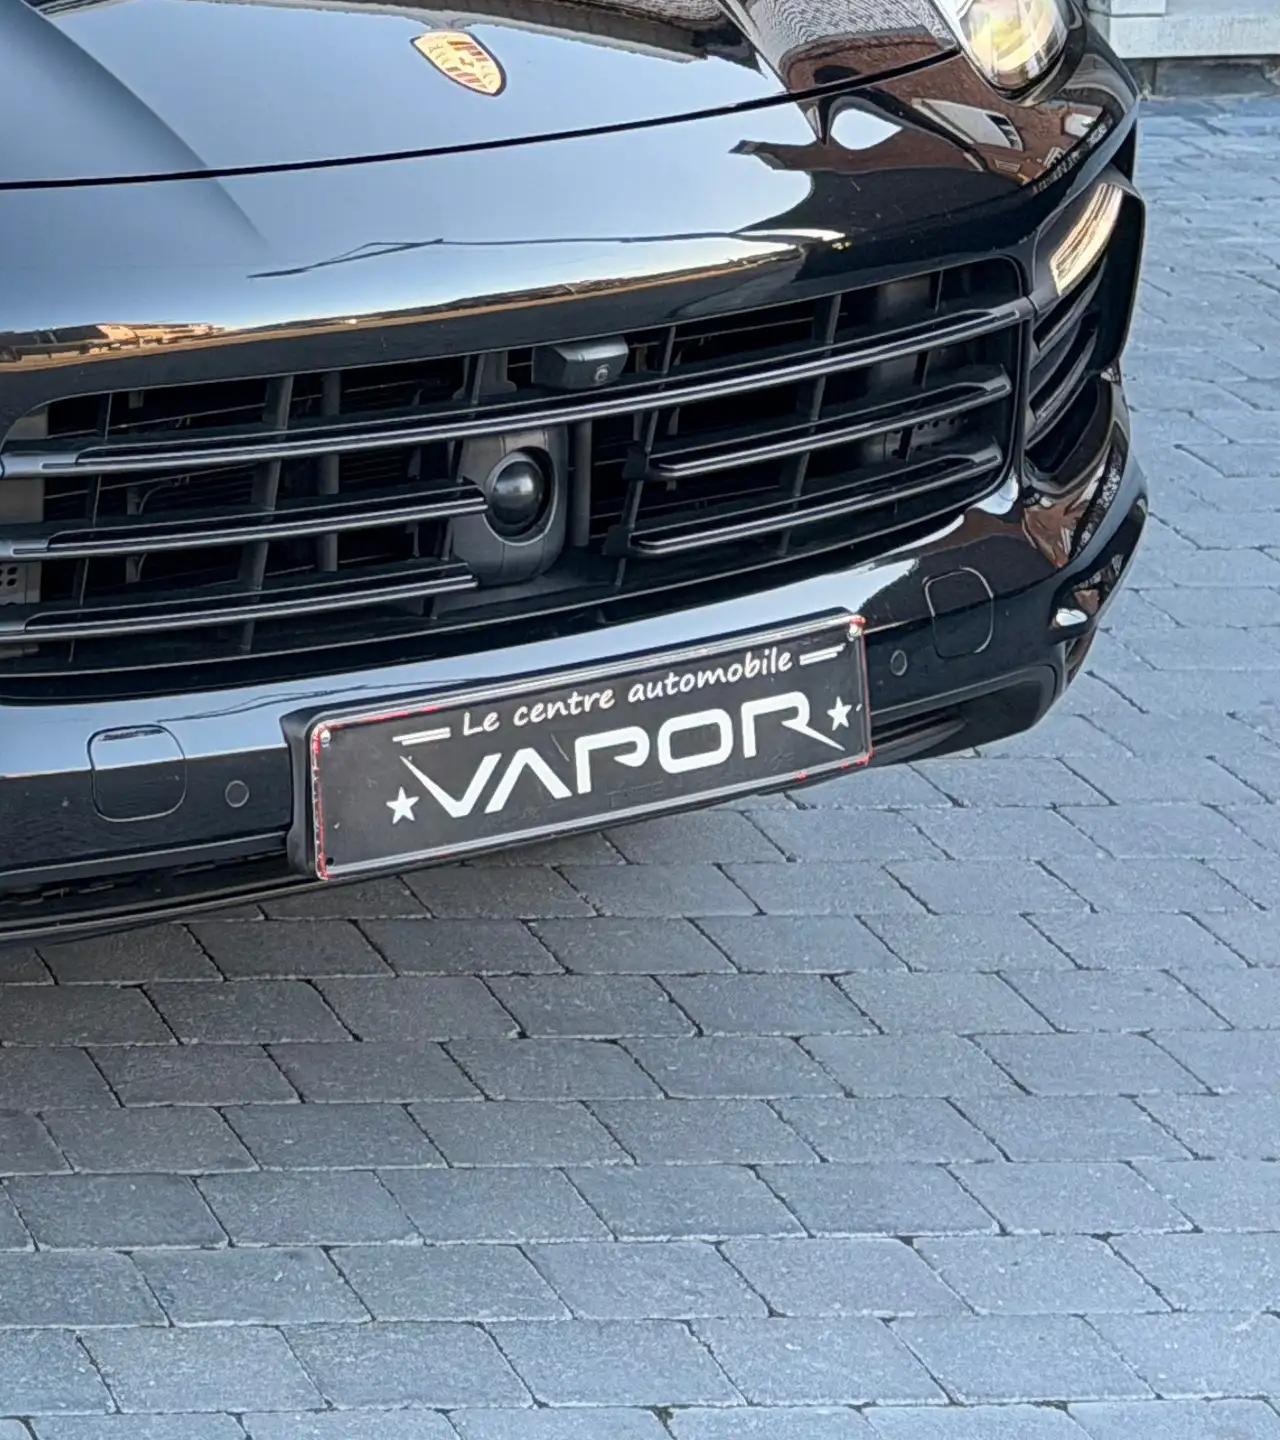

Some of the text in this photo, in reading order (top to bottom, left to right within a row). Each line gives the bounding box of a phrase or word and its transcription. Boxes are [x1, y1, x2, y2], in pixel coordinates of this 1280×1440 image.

[462, 646, 793, 737] Le centre automobile
[399, 689, 846, 819] VAPOR
